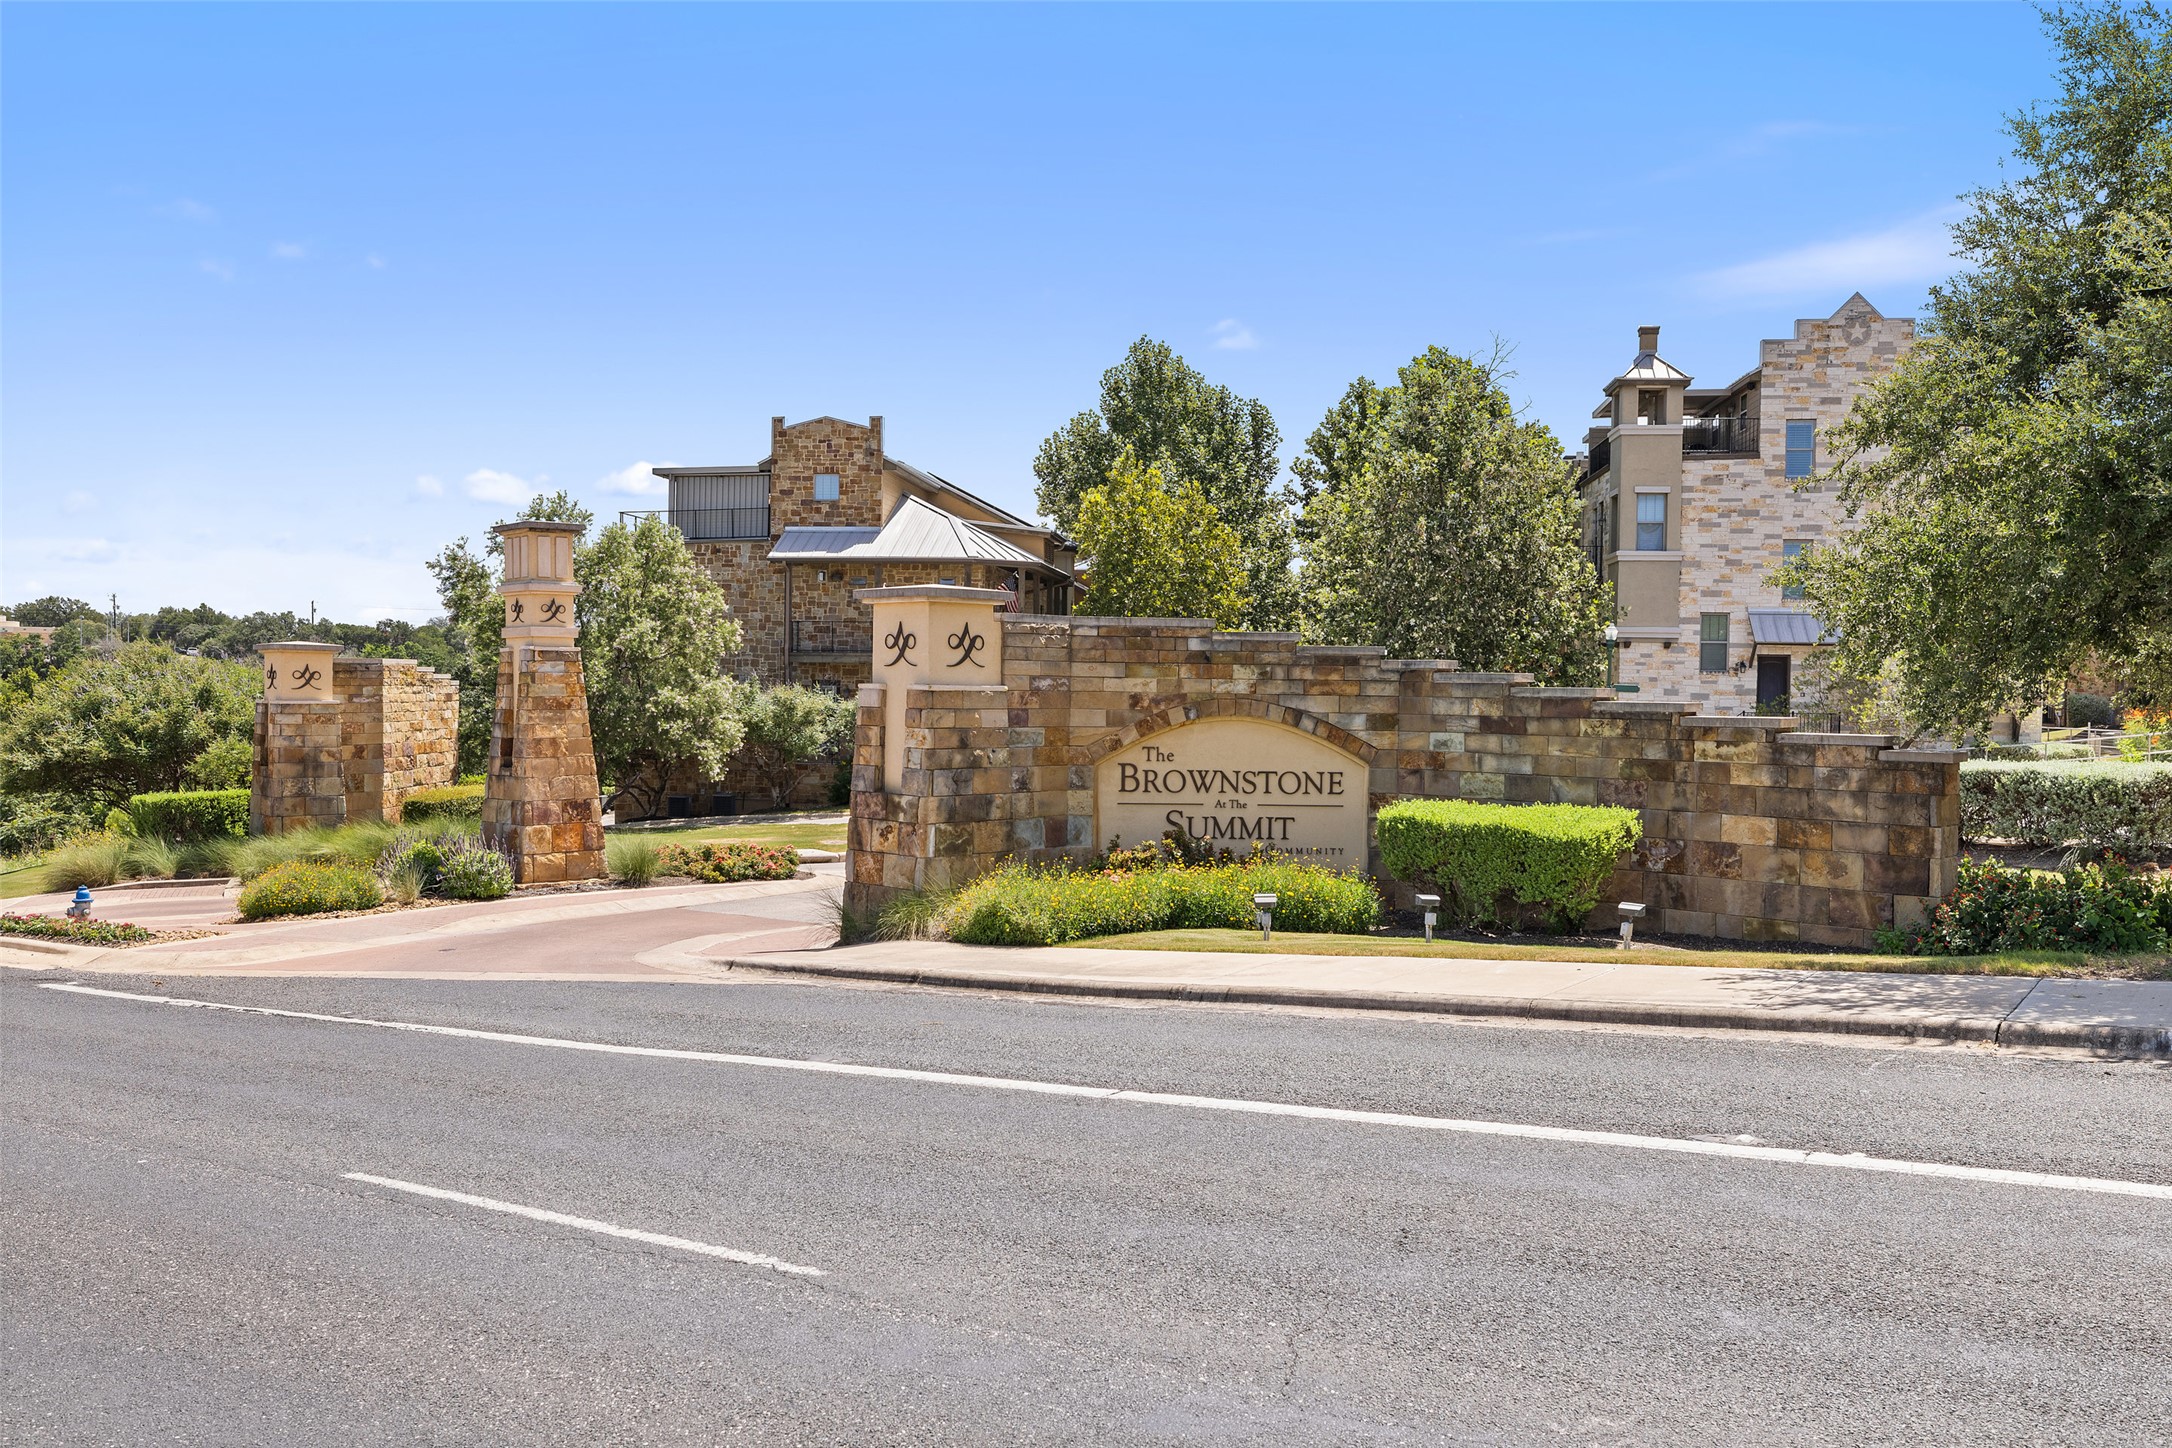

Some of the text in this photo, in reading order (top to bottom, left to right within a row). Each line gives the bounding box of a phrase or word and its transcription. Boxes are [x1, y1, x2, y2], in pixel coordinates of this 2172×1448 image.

[1141, 746, 1175, 762] The
[1117, 762, 1344, 795] BROWNSTONE
[1214, 799, 1248, 809] At The
[1165, 809, 1296, 840] SUMMIT
